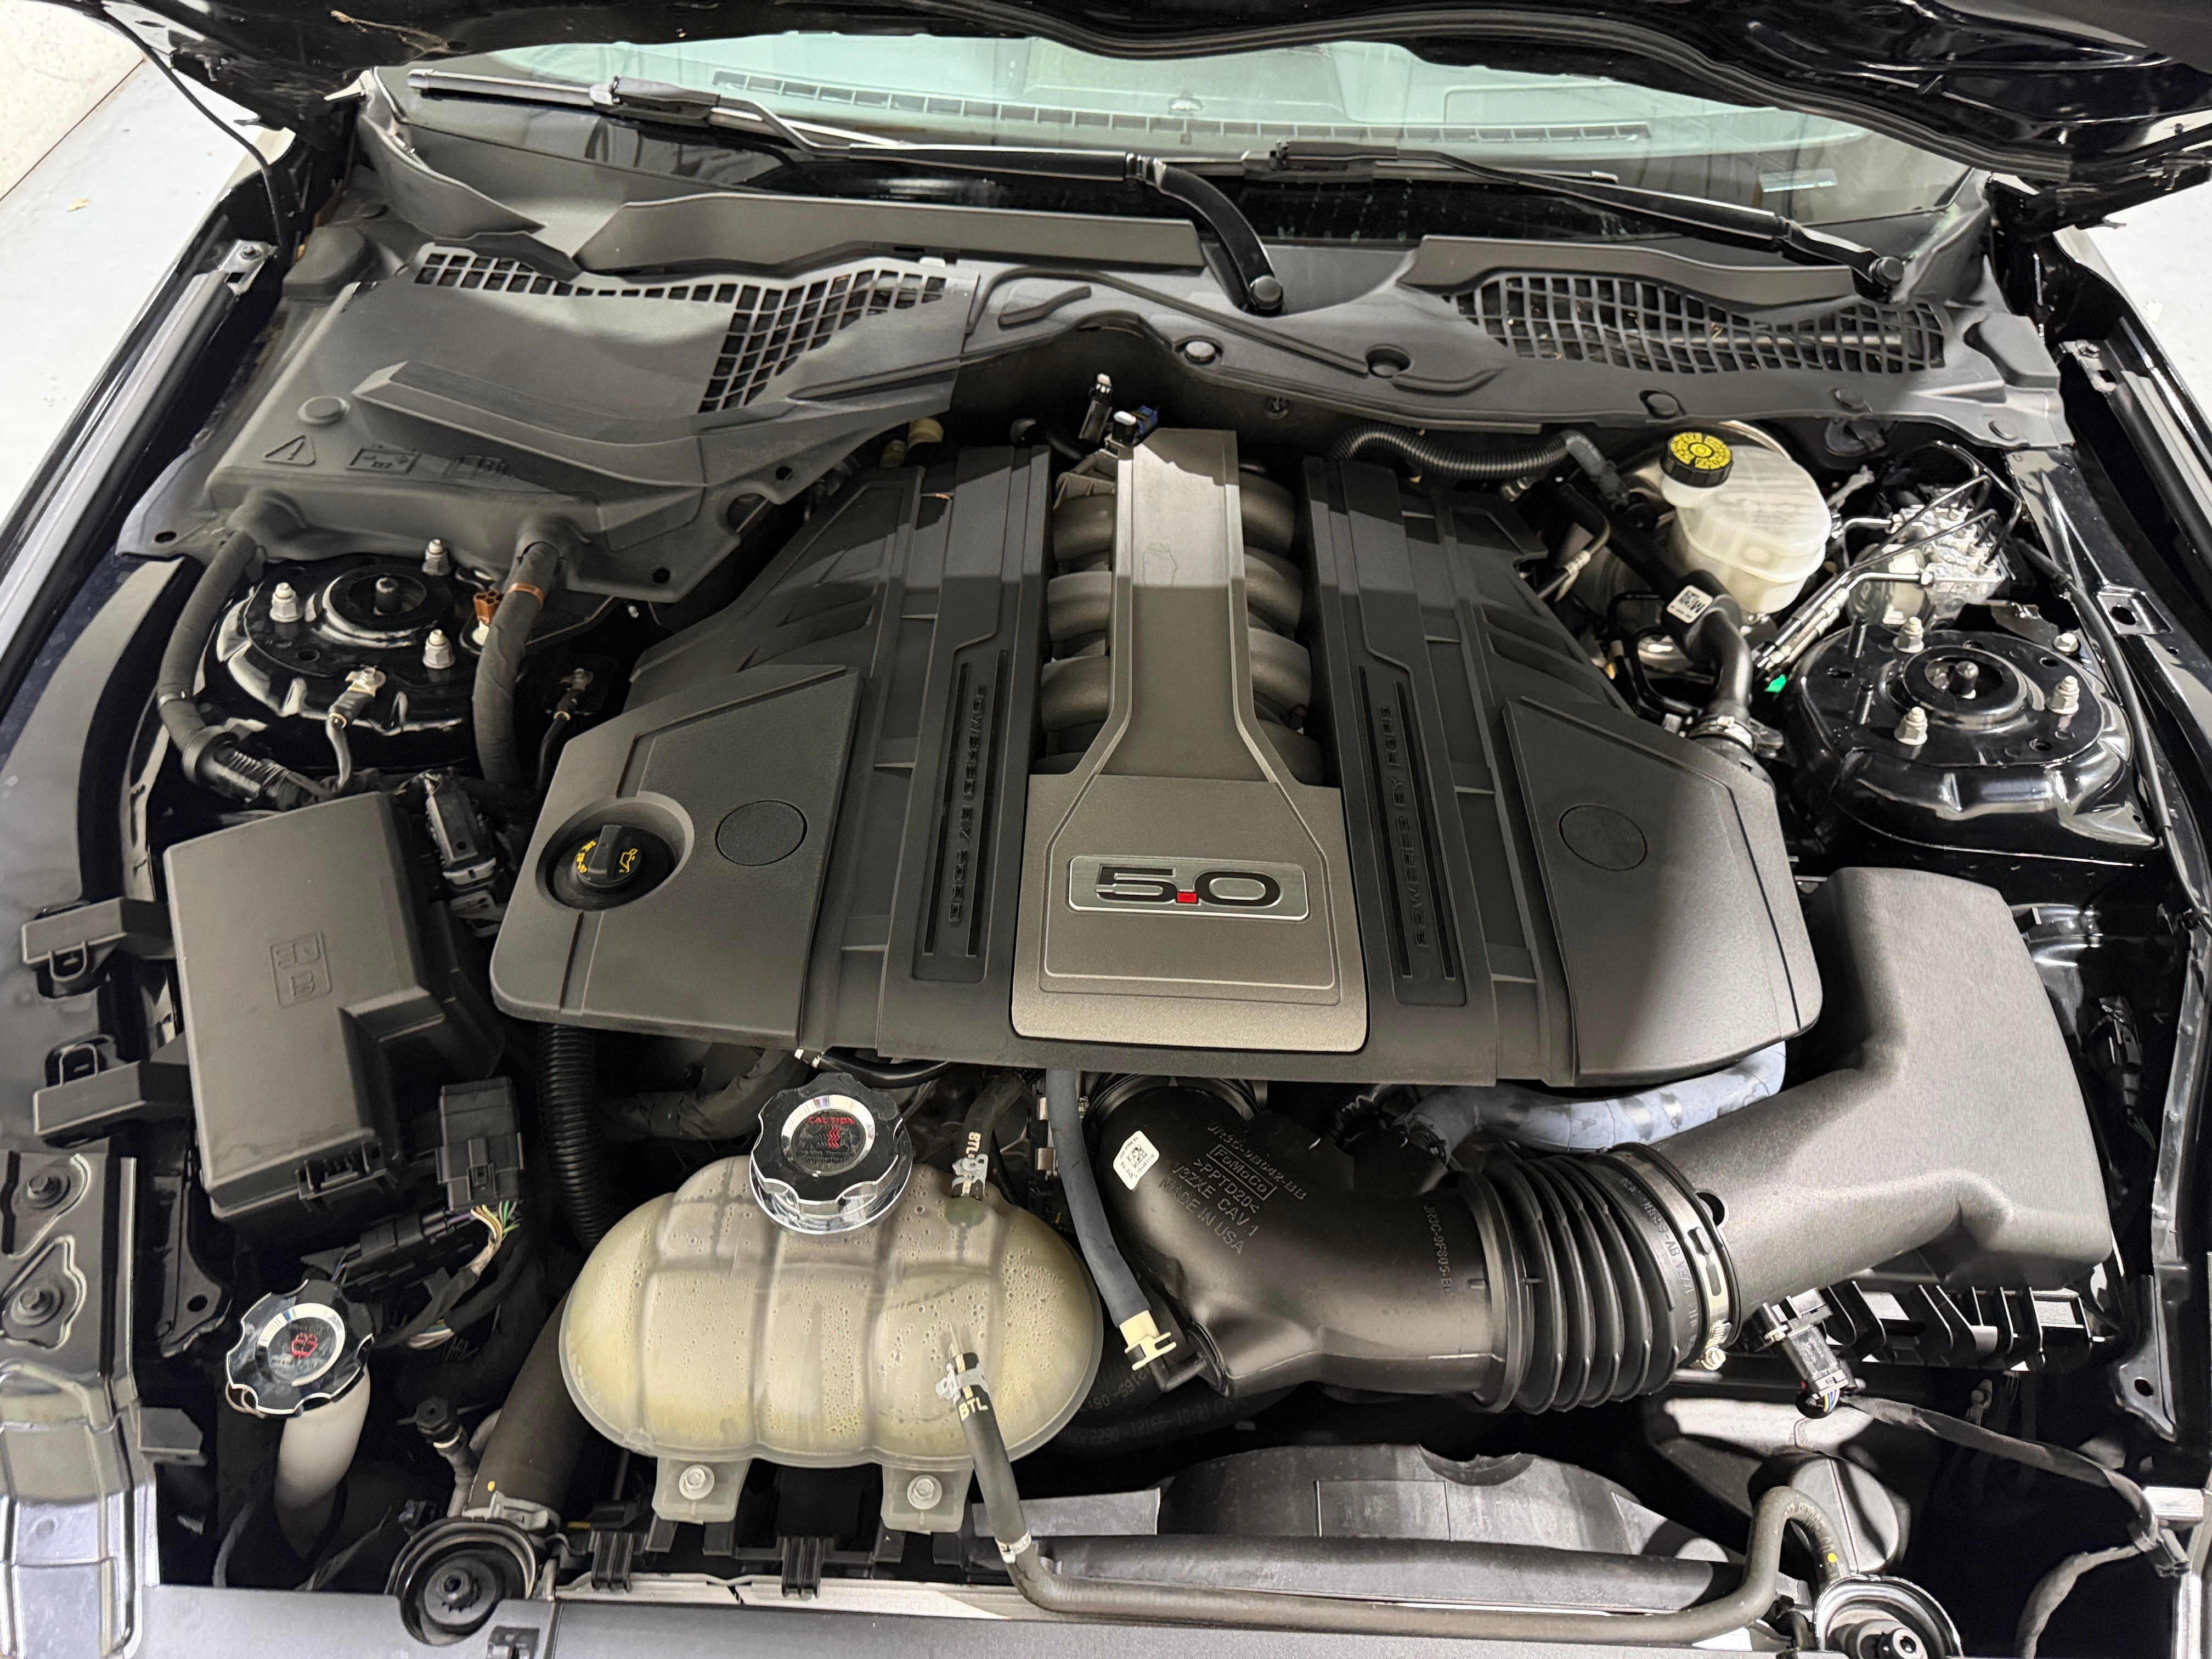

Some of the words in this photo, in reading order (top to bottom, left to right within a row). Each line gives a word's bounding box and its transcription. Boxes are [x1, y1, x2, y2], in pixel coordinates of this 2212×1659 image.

[963, 684, 986, 800] POWERED
[1378, 704, 1400, 766] FORD
[1390, 777, 1407, 803] BY
[960, 805, 973, 844] BY
[949, 848, 968, 923] FORD
[1095, 863, 1284, 907] 5.0
[1392, 816, 1431, 948] POWERED
[807, 1116, 854, 1125] CAUTION
[1172, 1161, 1216, 1199] V3ZXE
[1217, 1198, 1250, 1227] CAV
[1214, 1149, 1267, 1193] FoMoCo
[1159, 1177, 1200, 1212] MADE
[1198, 1207, 1216, 1226] IN
[1215, 1224, 1244, 1255] USA
[958, 1396, 989, 1421] BTL
